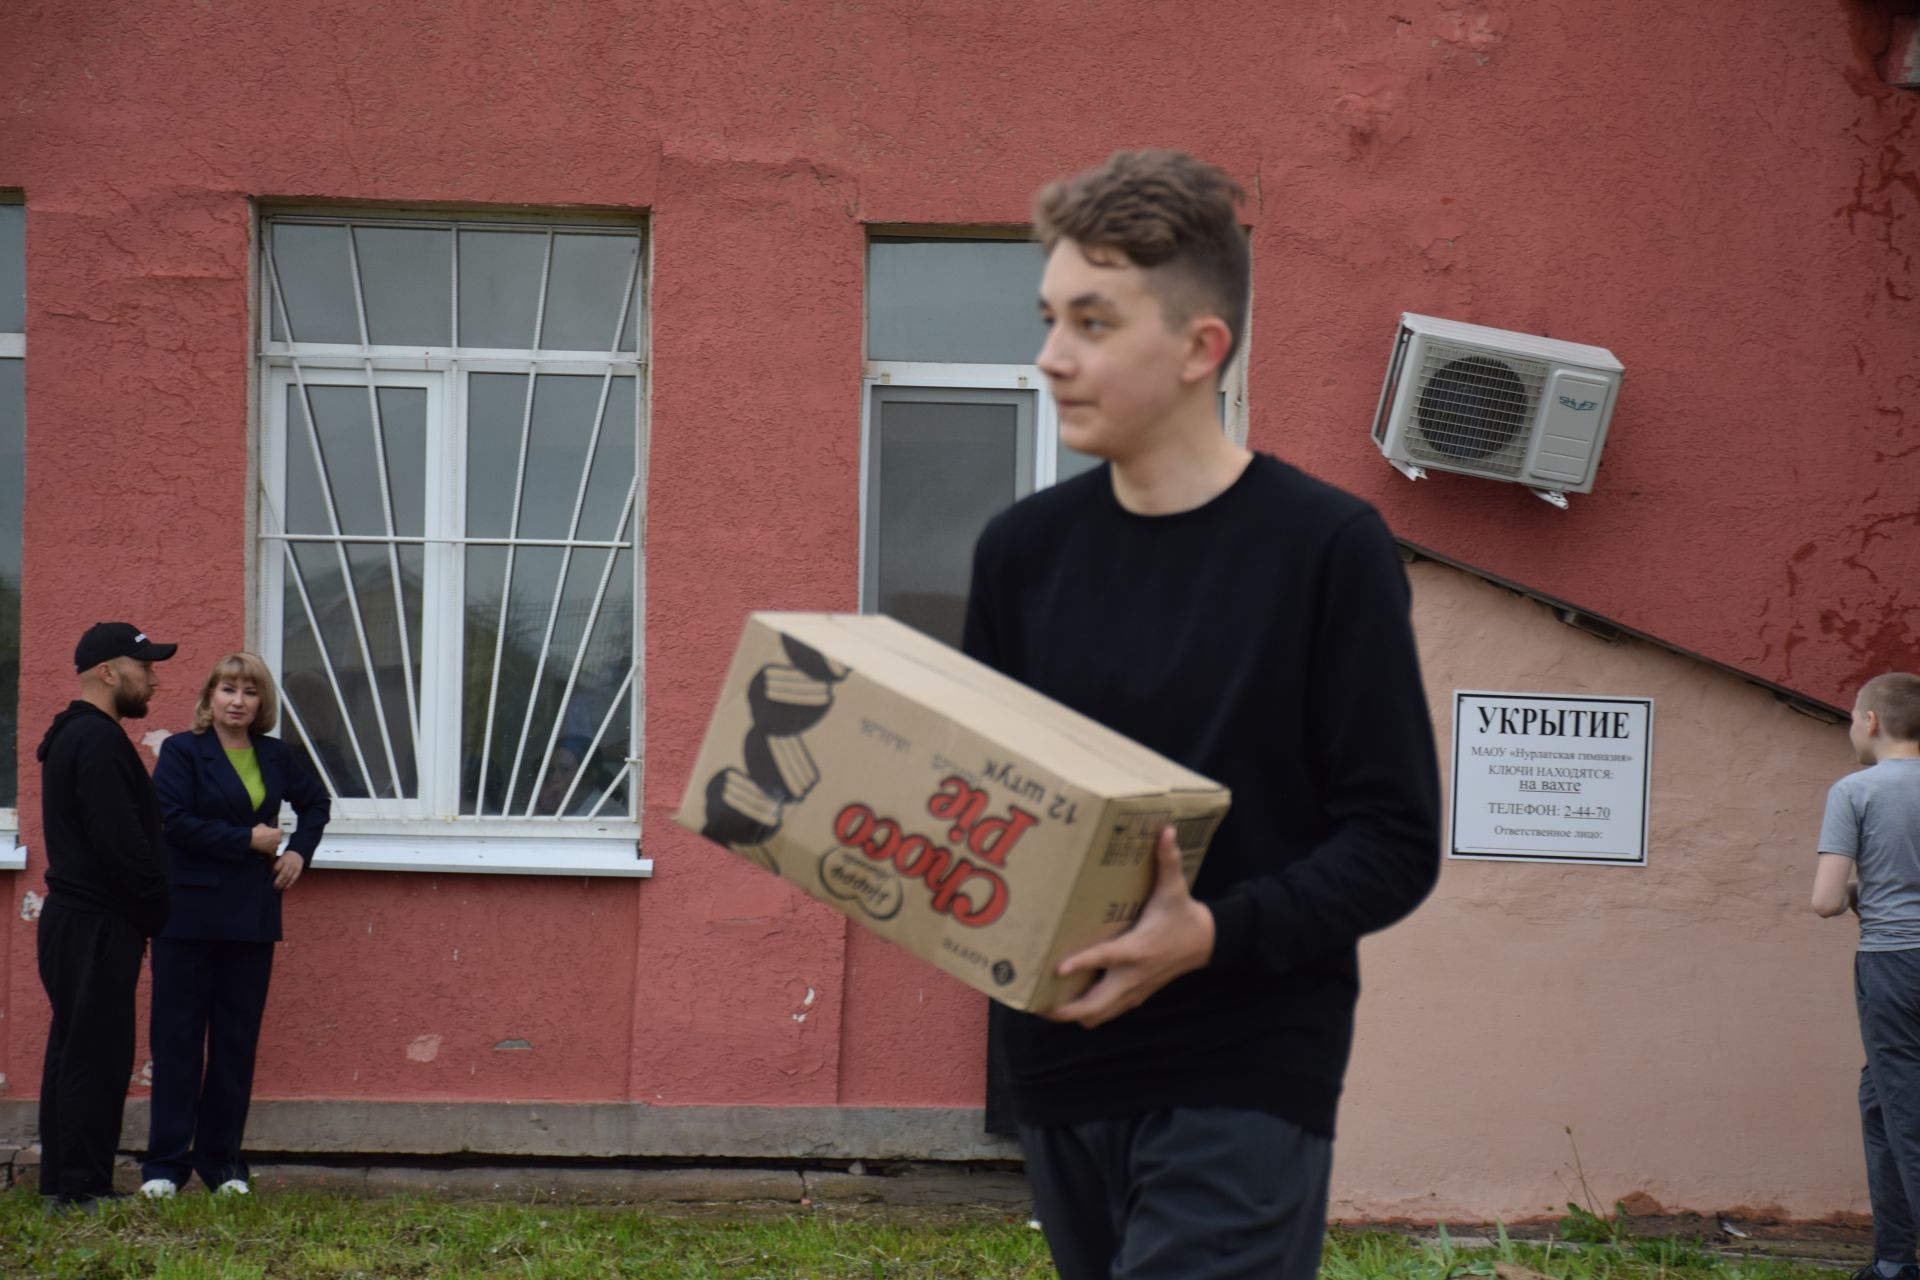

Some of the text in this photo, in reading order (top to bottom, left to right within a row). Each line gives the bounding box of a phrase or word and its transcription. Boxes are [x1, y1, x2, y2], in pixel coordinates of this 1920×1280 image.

[1477, 706, 1630, 739] УКРЫТИЕ
[1471, 746, 1633, 762] МАОУ «Нурлатская гимназия»
[983, 757, 1045, 803] штук
[1488, 764, 1614, 780] КЛЮЧИ НАХОДЯТСЯ:
[1519, 780, 1582, 793] на вахте
[927, 775, 1040, 870] Pie
[1047, 794, 1078, 825] 12
[1488, 802, 1611, 819] ТЕЛЕФОН: 2-44-70
[1494, 825, 1603, 840] Ответственное лицо:
[833, 803, 1009, 928] Choco
[831, 864, 889, 905] Happy
